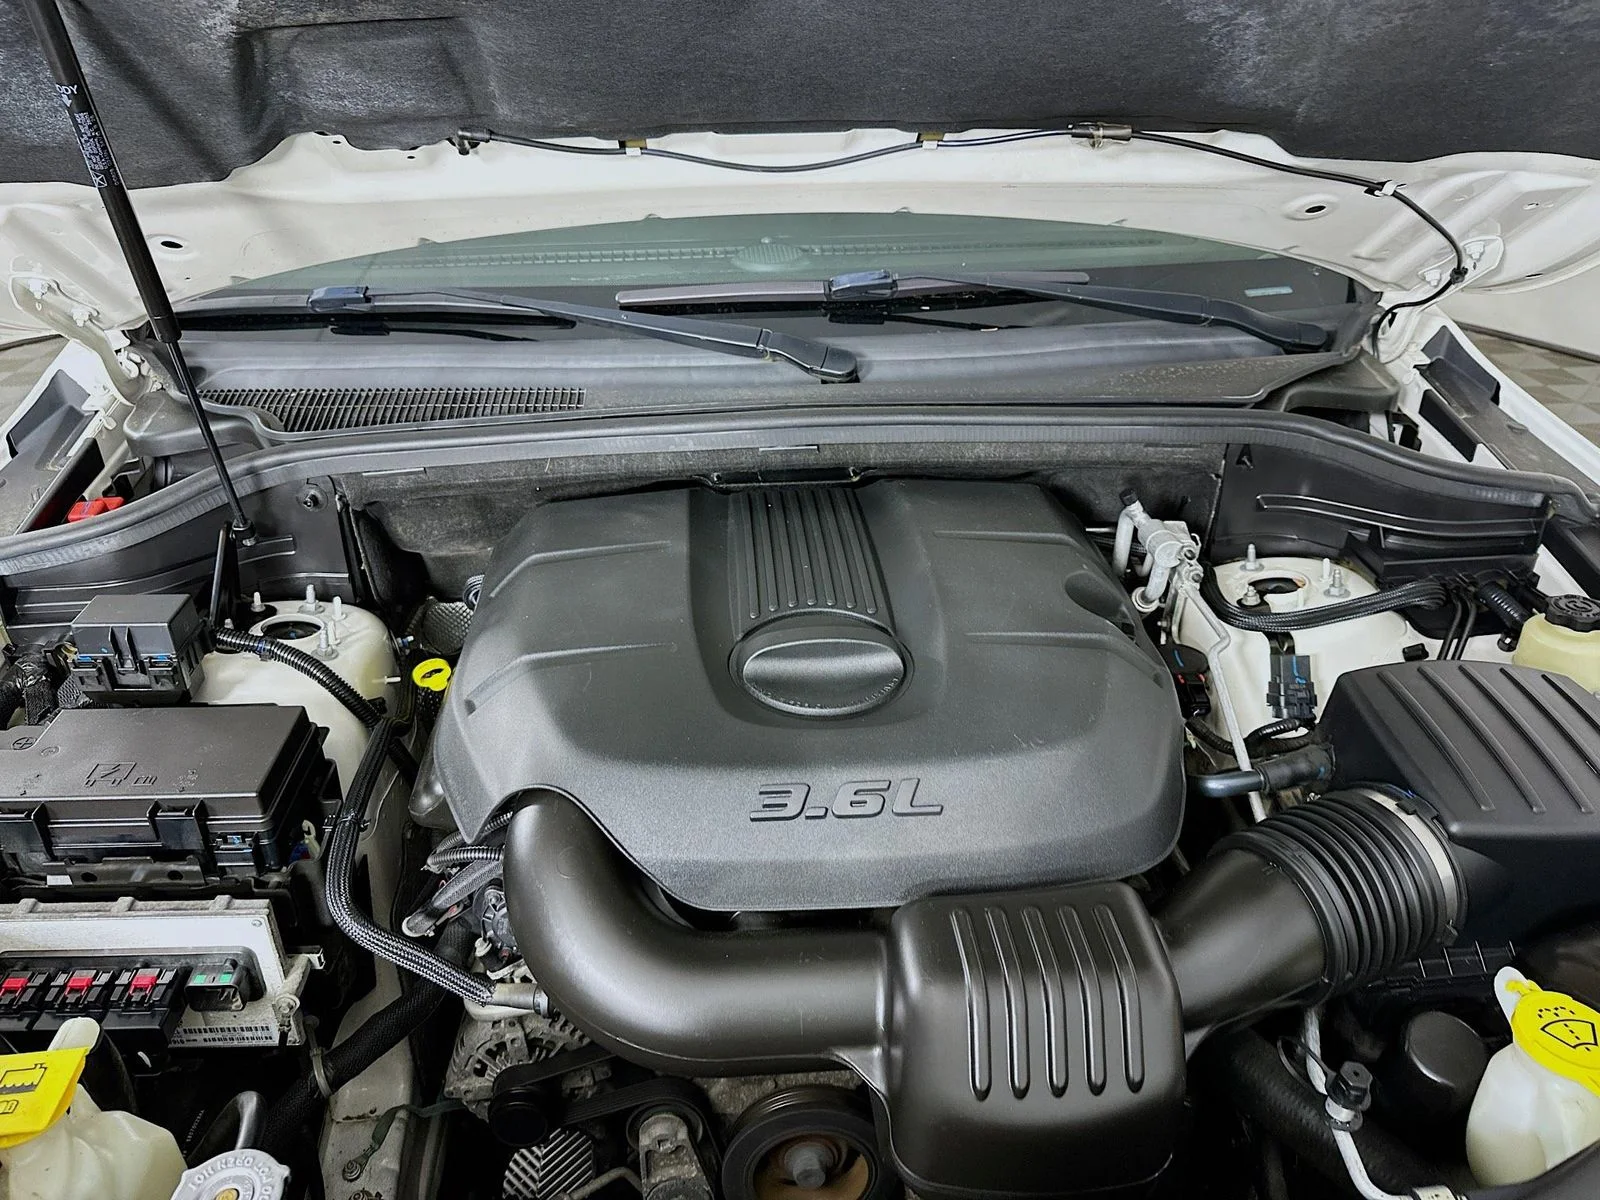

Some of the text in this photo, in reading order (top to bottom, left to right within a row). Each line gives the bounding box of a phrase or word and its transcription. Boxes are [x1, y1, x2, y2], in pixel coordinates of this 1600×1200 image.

[55, 83, 77, 95] ODY
[749, 777, 944, 822] 3.6L
[217, 1155, 254, 1171] OPEN
[188, 1167, 215, 1192] HOT
